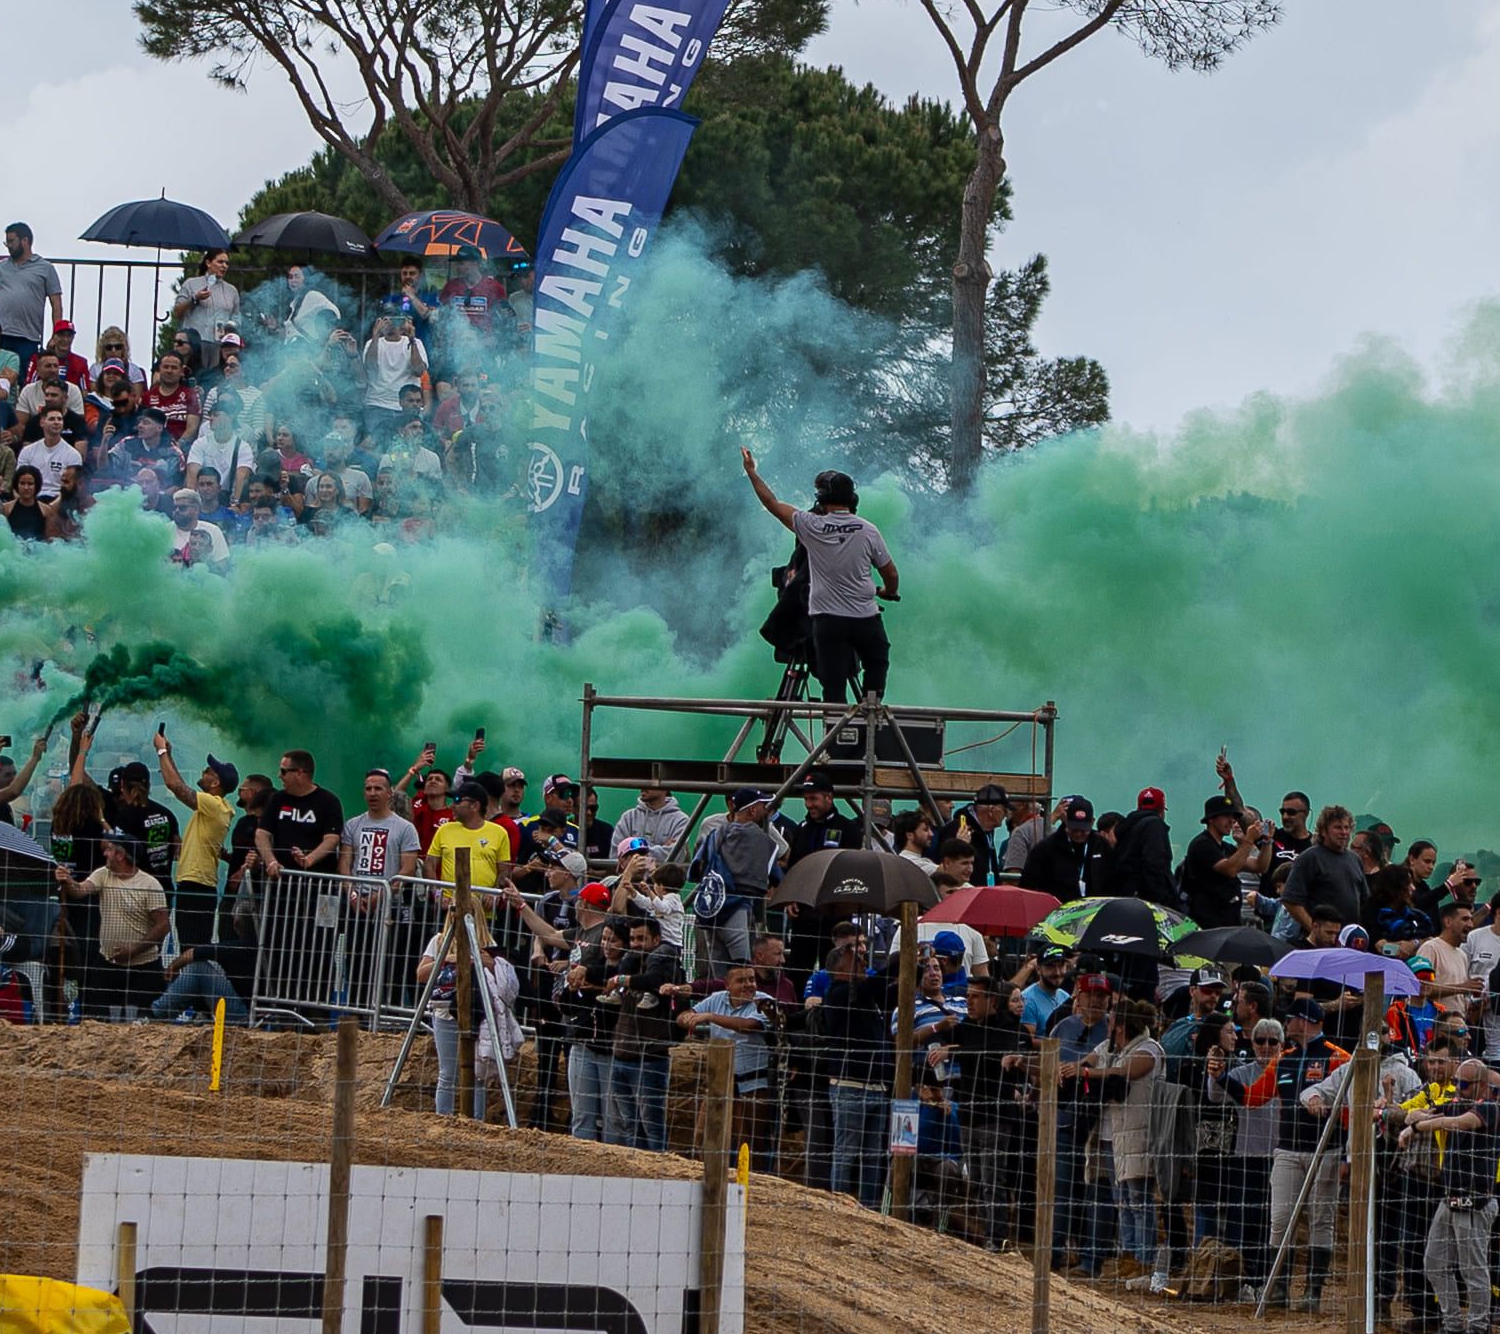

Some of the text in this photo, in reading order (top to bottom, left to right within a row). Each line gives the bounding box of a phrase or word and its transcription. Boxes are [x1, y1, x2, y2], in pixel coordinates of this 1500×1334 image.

[596, 3, 692, 128] AHA
[529, 195, 633, 431] YAMAHA
[822, 523, 864, 534] MXGP
[278, 805, 317, 824] FILA
[359, 833, 387, 846] NY
